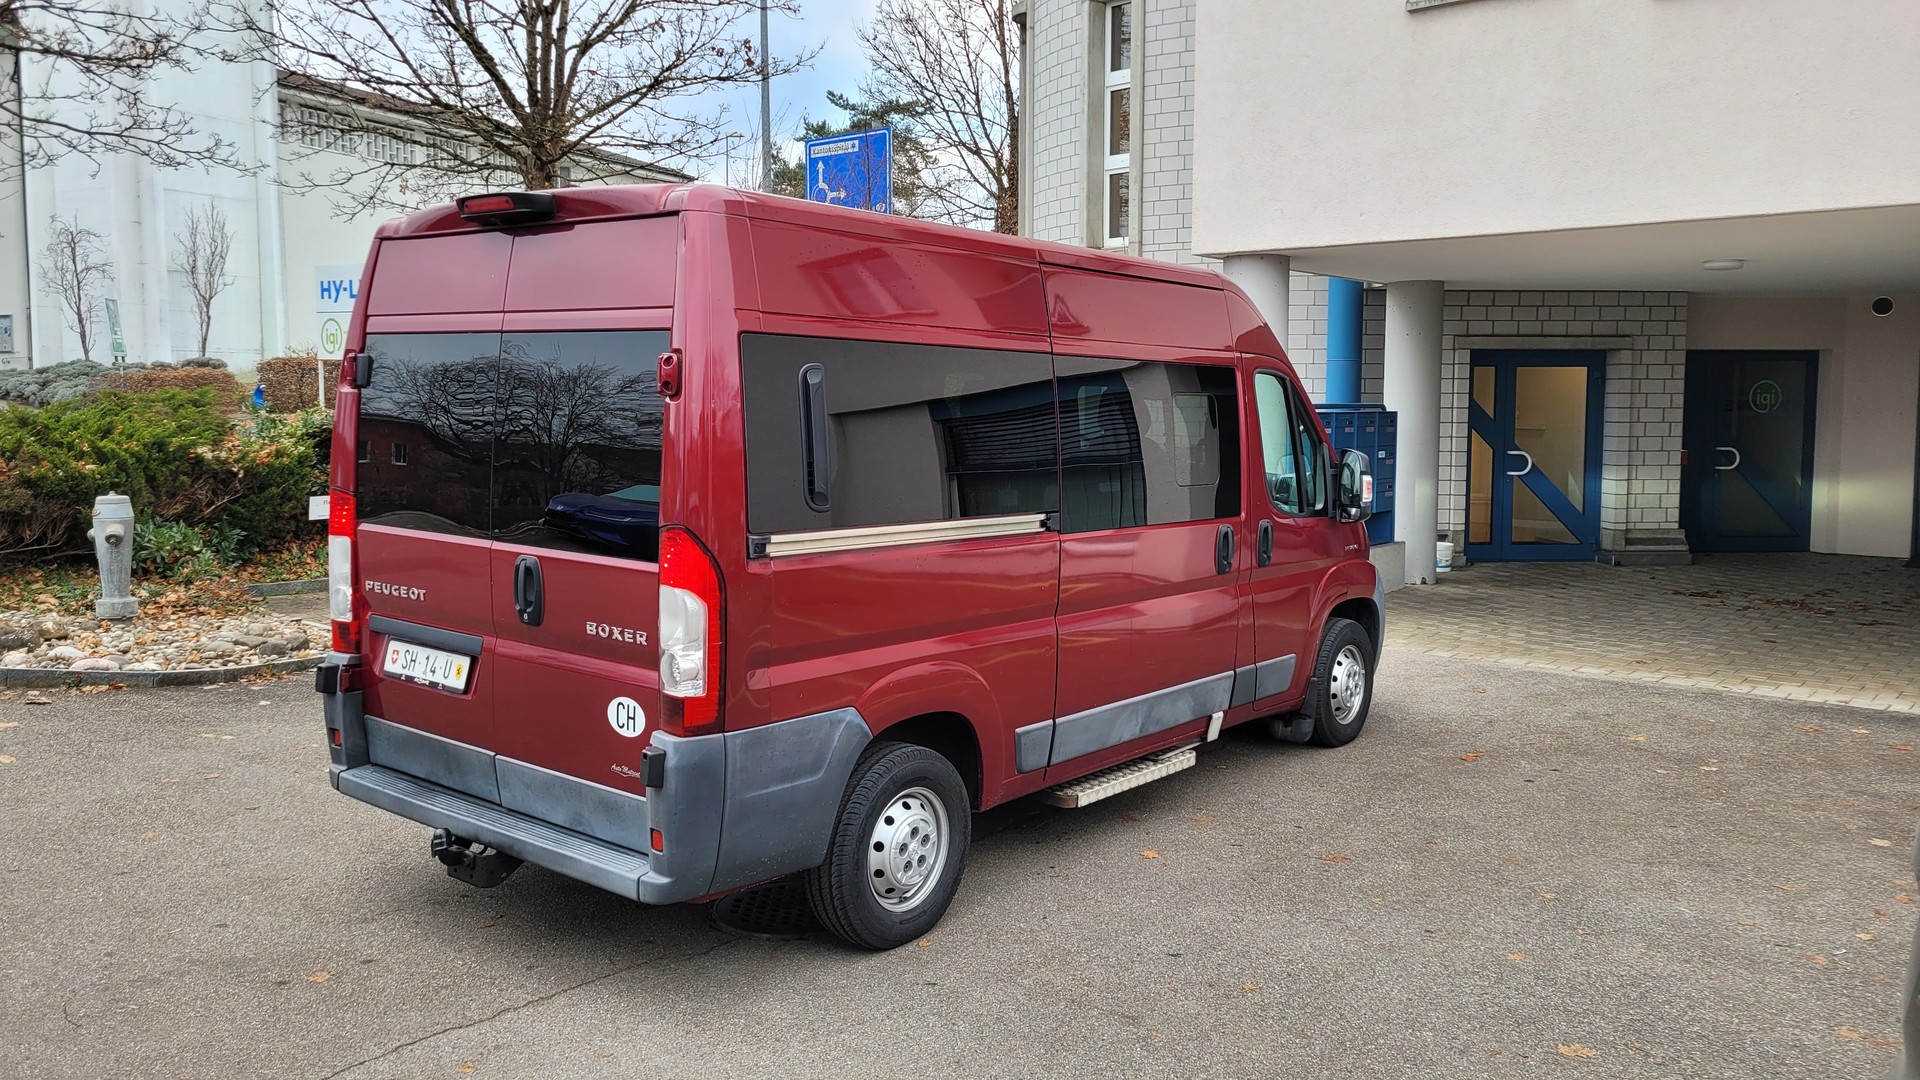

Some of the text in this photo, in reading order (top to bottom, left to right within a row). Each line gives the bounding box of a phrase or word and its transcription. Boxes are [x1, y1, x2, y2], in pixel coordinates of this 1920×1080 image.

[320, 280, 360, 303] HY-L
[365, 580, 427, 601] PEUGEOT
[586, 621, 648, 646] BOXER
[616, 701, 636, 732] CH
